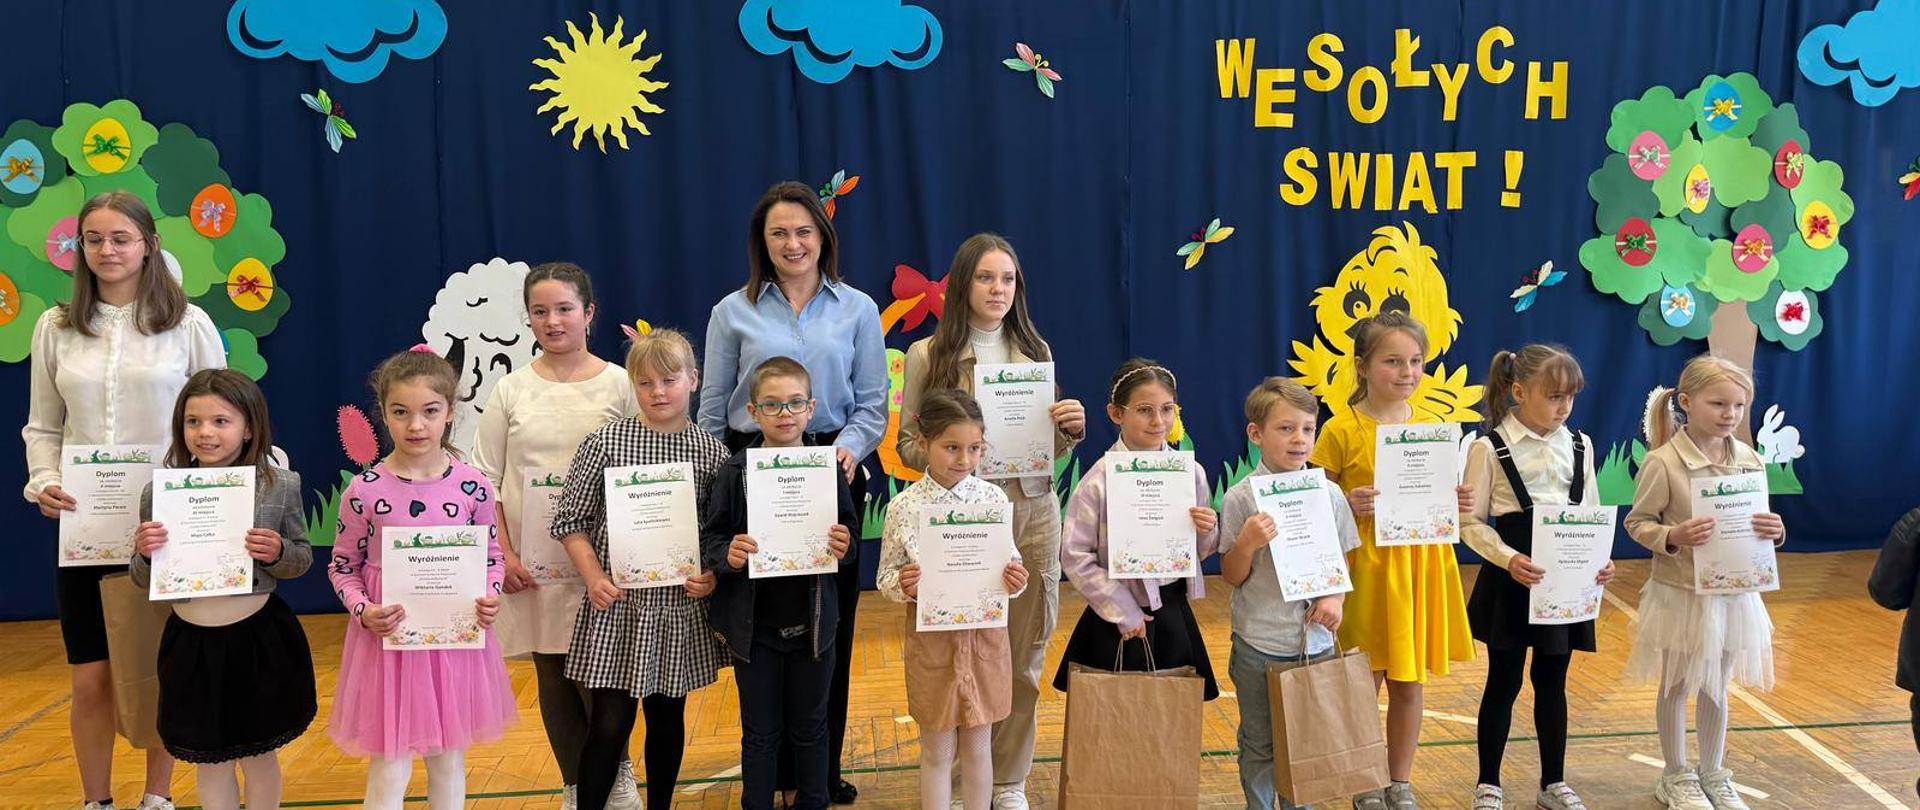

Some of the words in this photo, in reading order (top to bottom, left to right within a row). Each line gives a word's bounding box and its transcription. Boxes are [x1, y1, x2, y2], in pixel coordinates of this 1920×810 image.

[1215, 26, 1569, 128] WESOŁYCH
[1403, 449, 1430, 457] Dyplom
[95, 470, 126, 478] Dyplom
[777, 475, 806, 484] Dyplom
[1136, 479, 1164, 487] Dyplom
[628, 489, 673, 500] Wyróżnienie
[188, 495, 220, 504] Dyplom
[1278, 499, 1304, 508] Dyplom
[942, 531, 988, 540] Wyróżnienie
[408, 554, 460, 563] Wyróżnienie
